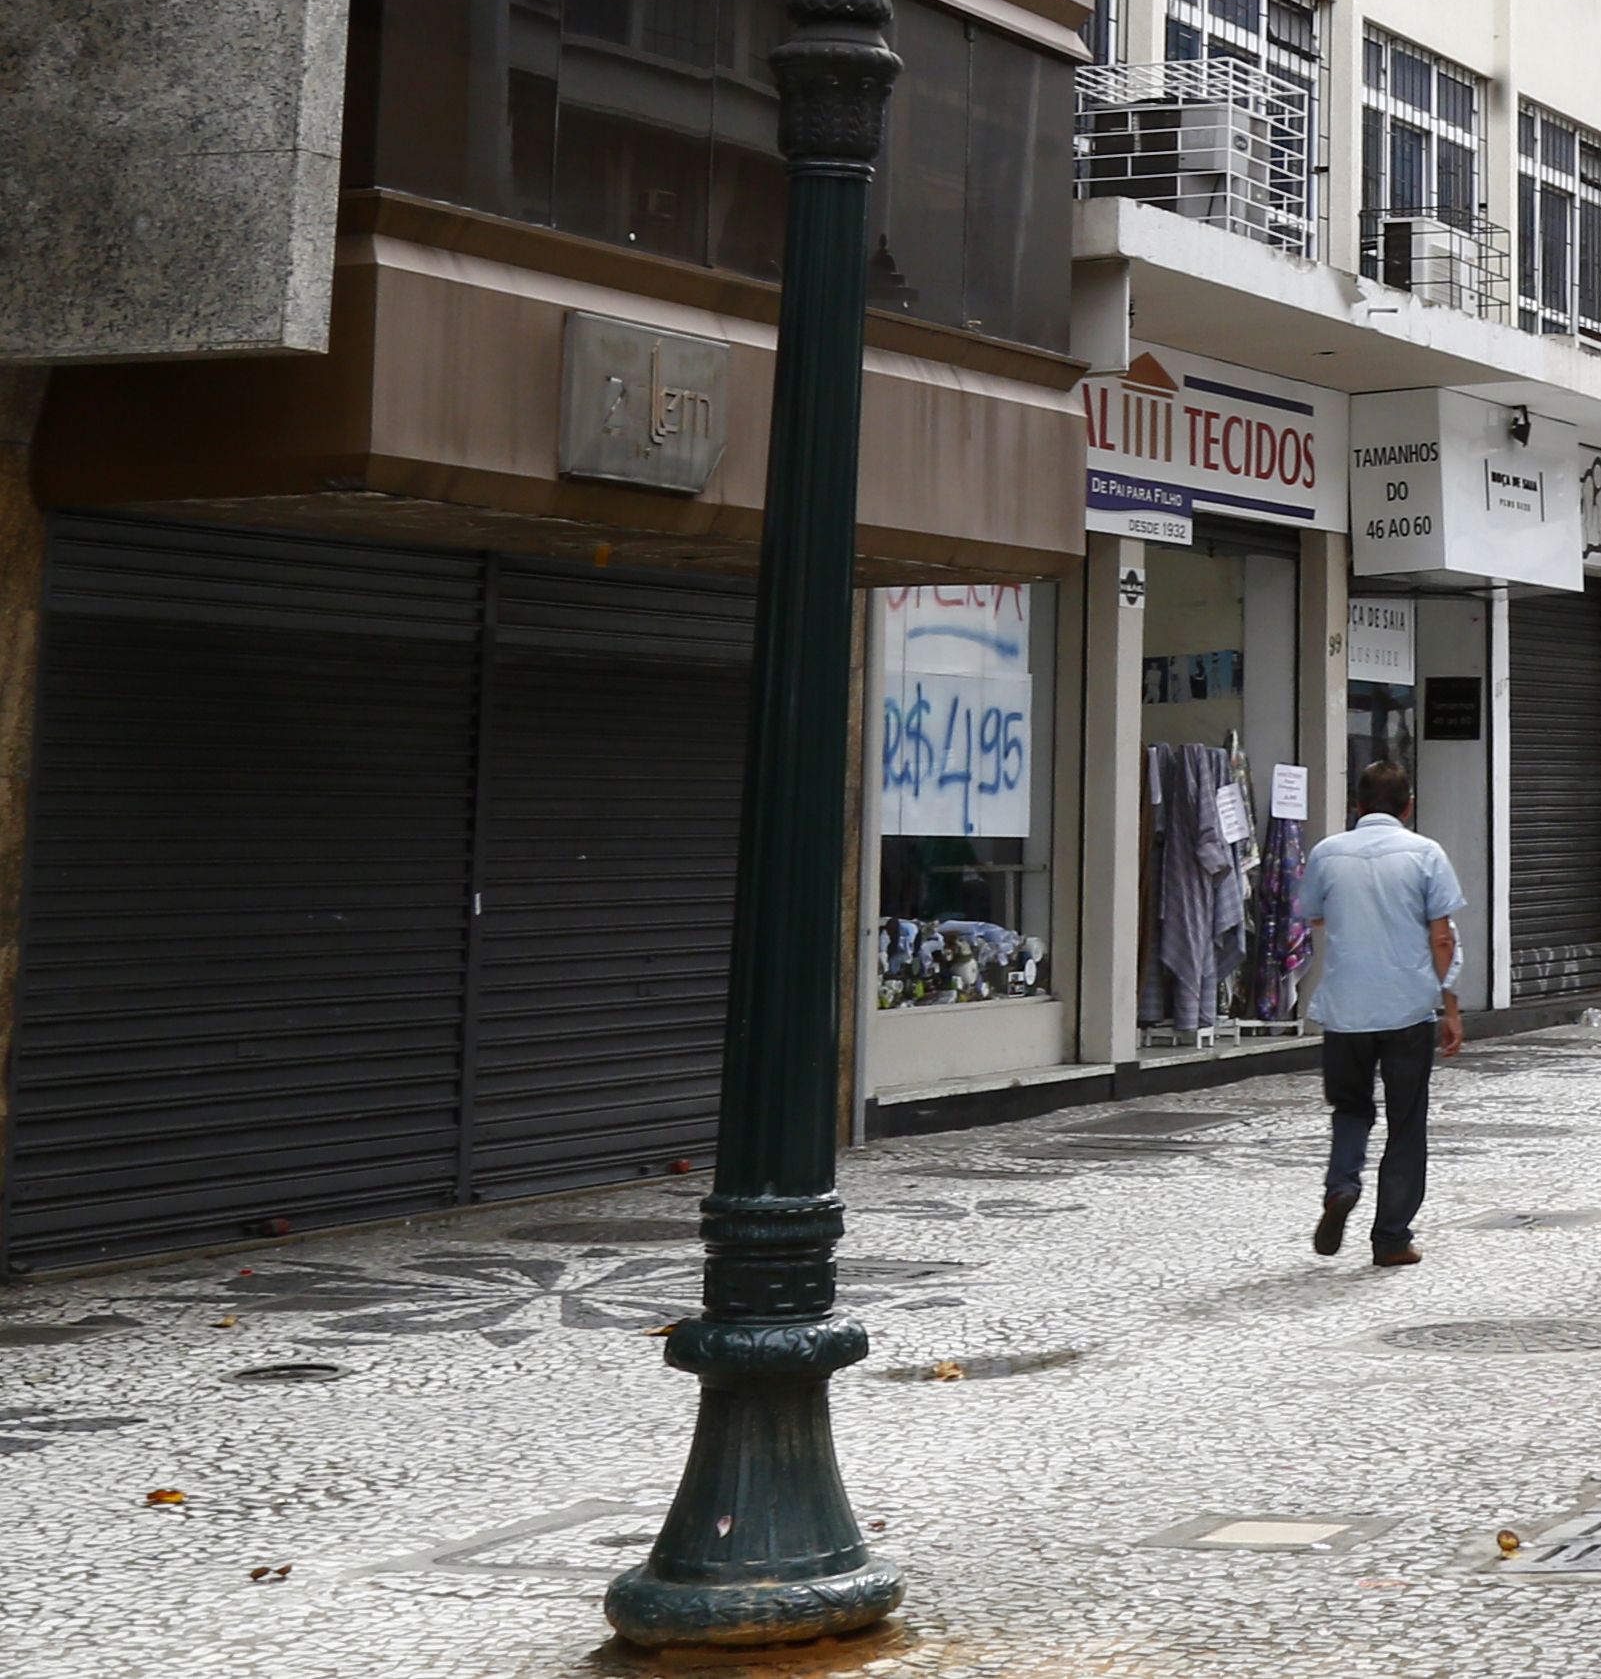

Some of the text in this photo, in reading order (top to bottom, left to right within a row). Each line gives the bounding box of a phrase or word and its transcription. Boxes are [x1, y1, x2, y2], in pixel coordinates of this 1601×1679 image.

[1183, 405, 1315, 488] TECIDOS
[1354, 442, 1438, 467] TAMANHOS
[1386, 481, 1408, 502] DO
[1512, 476, 1521, 489] DE
[1128, 519, 1186, 539] DESDE 1932
[1366, 515, 1431, 539] 46 AO 60
[1368, 606, 1380, 628] DE
[1383, 607, 1405, 632] SAIA
